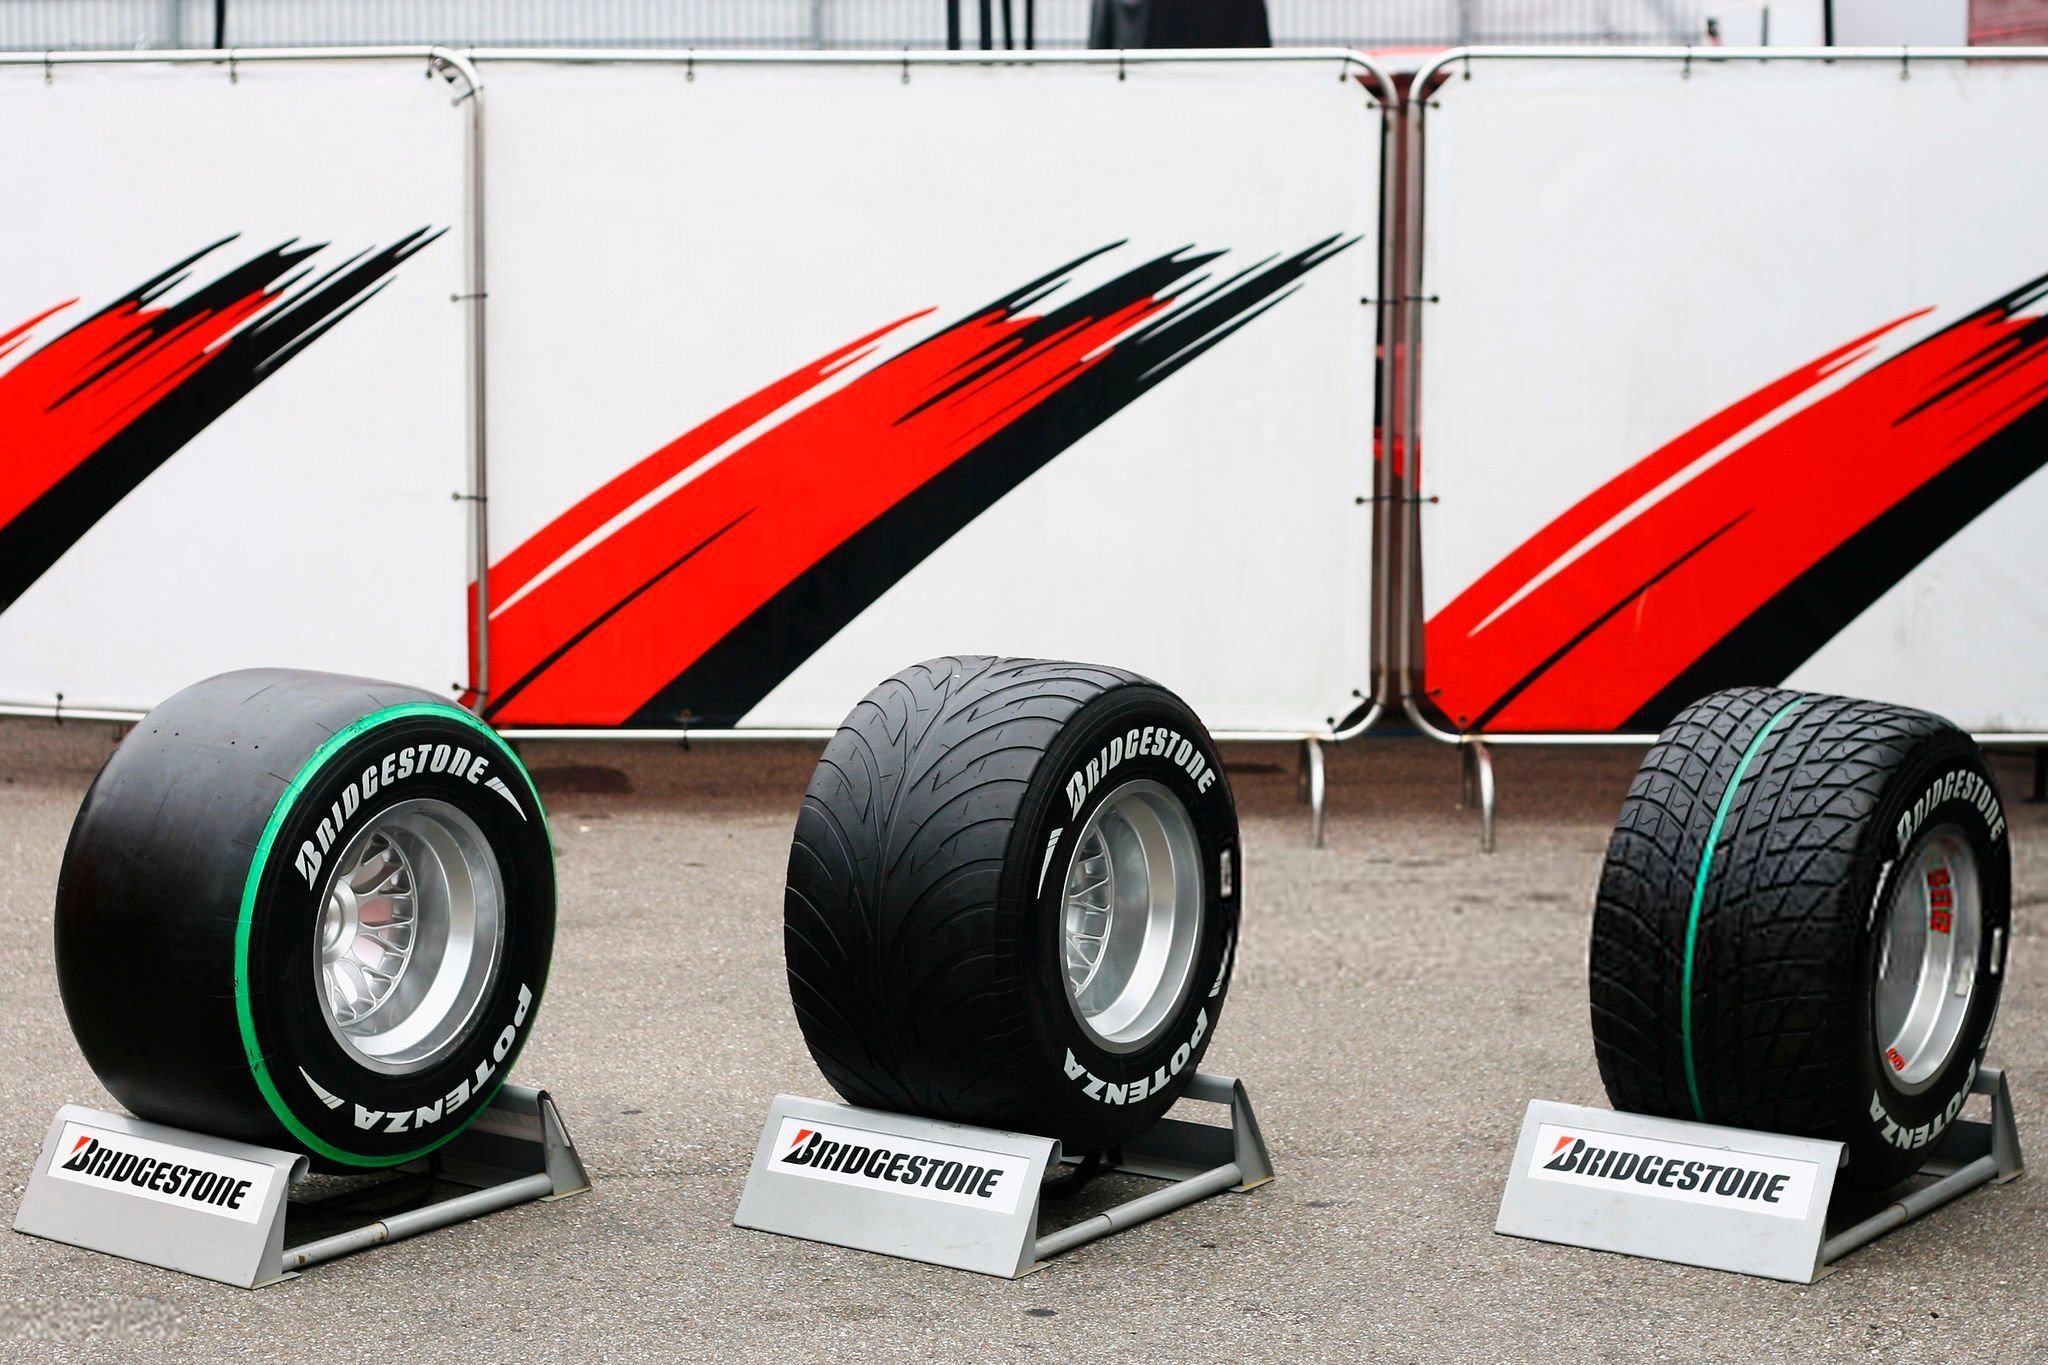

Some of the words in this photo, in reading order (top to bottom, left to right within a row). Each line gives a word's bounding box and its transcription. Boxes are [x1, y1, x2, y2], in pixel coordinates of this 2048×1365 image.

[295, 744, 489, 890] BRIDGESTONE
[1065, 727, 1216, 820] BRIDGESTONE
[1897, 769, 2005, 855] BRIDGESTONE
[354, 983, 532, 1133] POTENZA
[1064, 1007, 1208, 1106] POTENZA
[1869, 1058, 1976, 1150] POTENZA
[62, 1136, 252, 1210] BRIDGESTONE
[782, 1129, 1004, 1198] BRIDGESTONE
[1543, 1136, 1790, 1203] BRIDGESTONE
